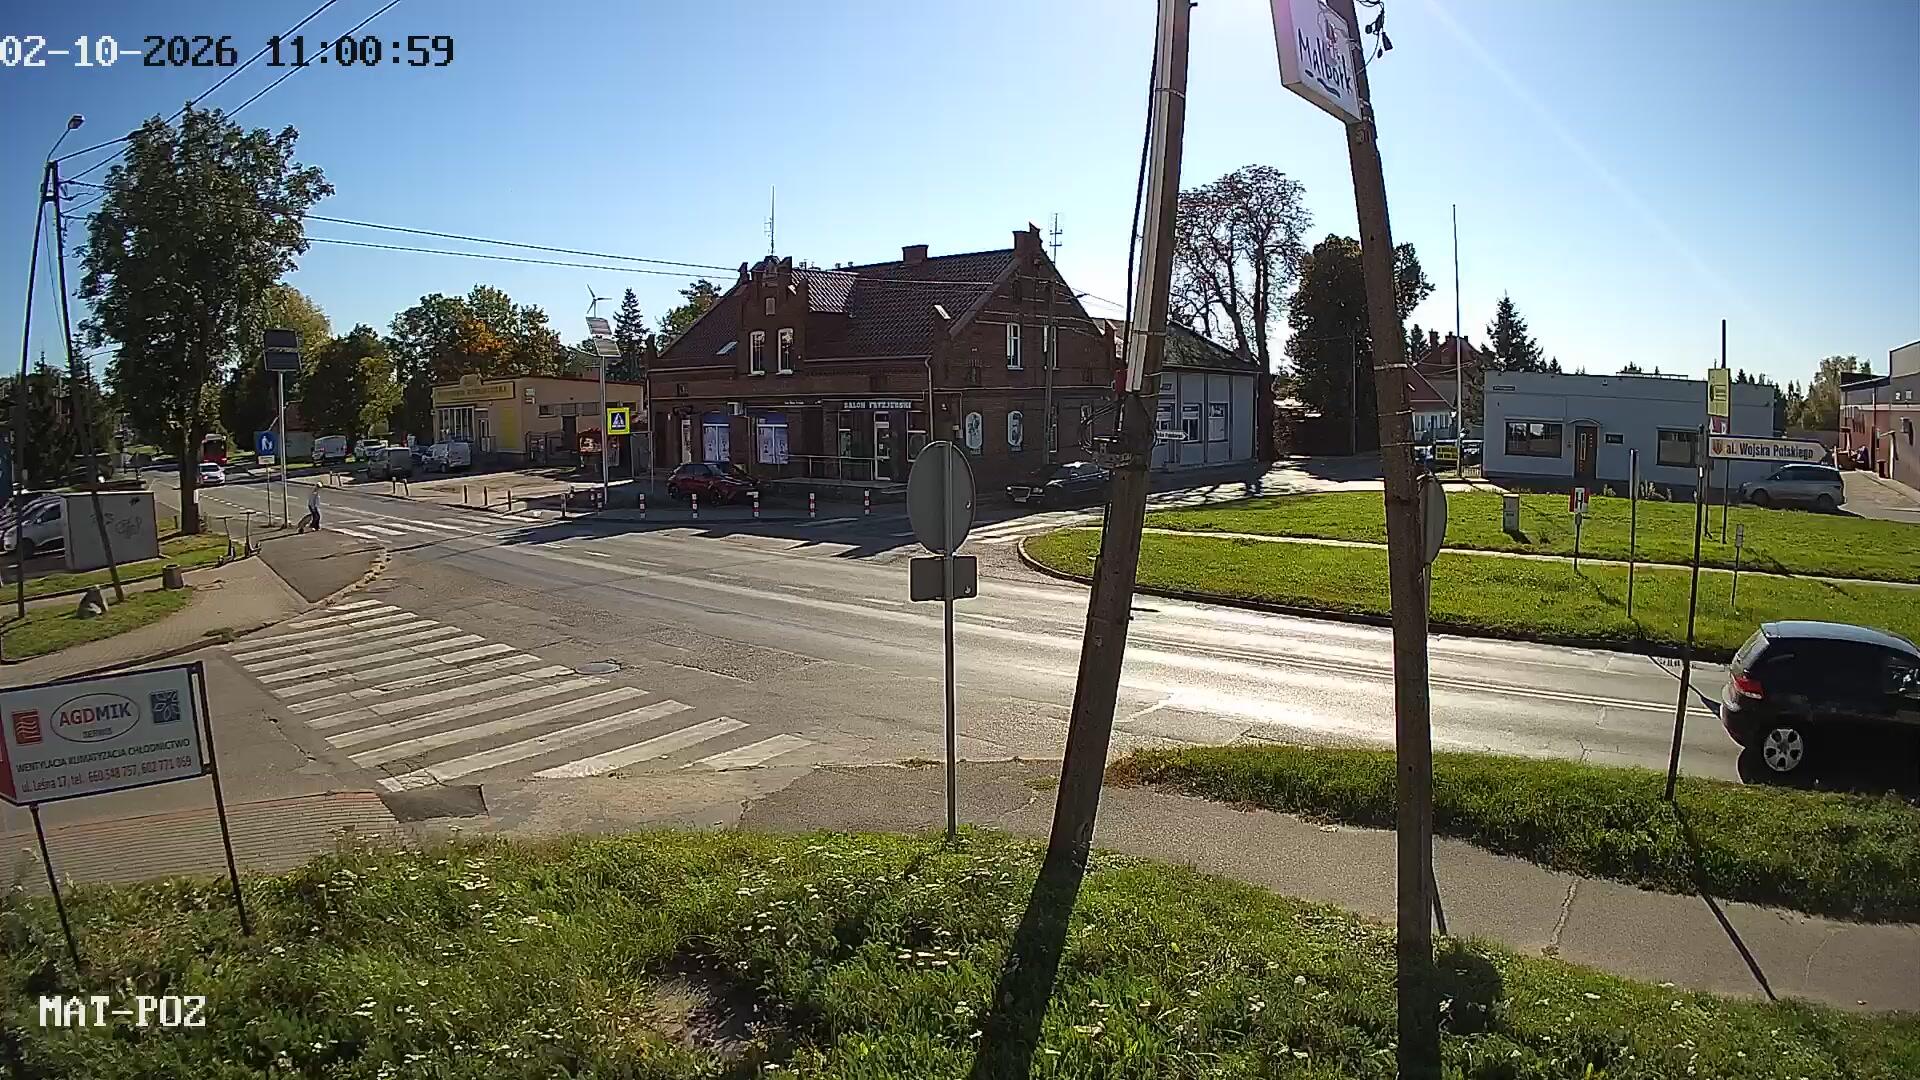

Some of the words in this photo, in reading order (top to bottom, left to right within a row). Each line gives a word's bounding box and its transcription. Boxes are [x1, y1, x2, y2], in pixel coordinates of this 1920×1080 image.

[1726, 444, 1737, 455] al.
[1740, 443, 1770, 457] Wojska
[1773, 445, 1814, 459] Polskiego
[59, 702, 132, 727] AGDMIK
[16, 757, 67, 773] WENTYLACJA
[69, 749, 126, 766] KLIMATYZACJA
